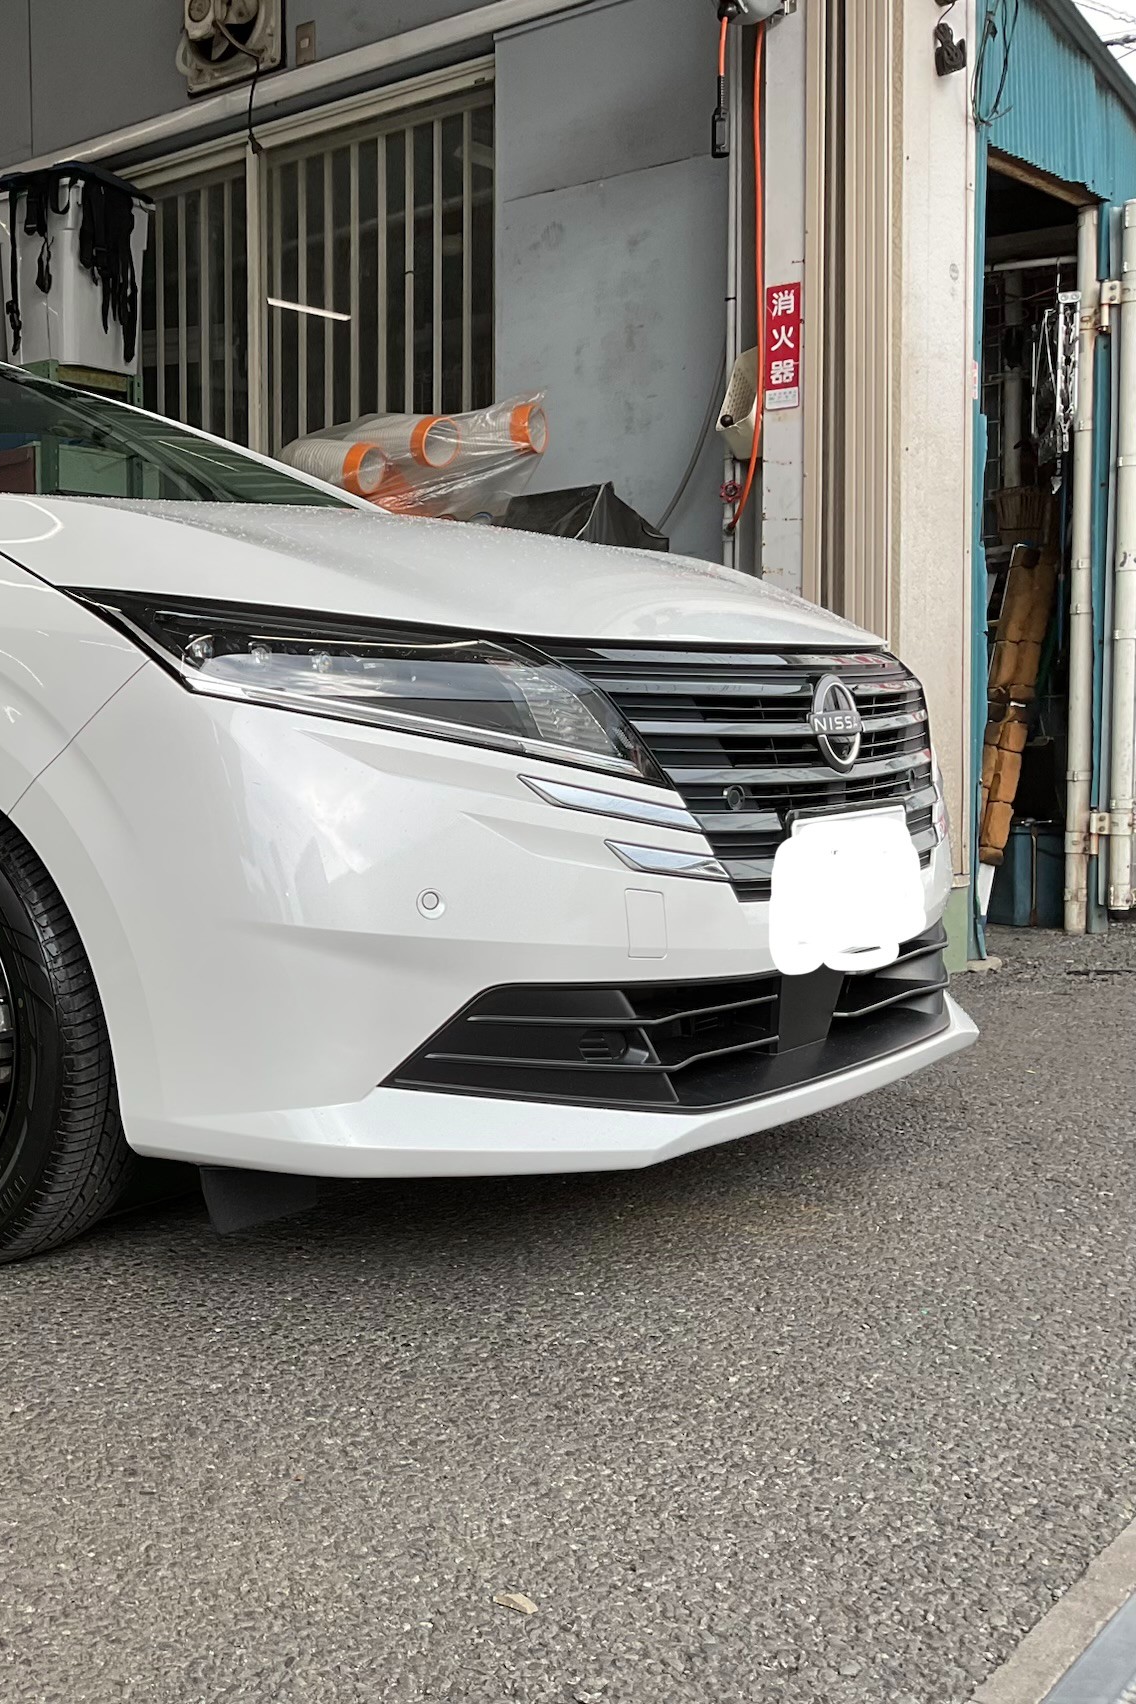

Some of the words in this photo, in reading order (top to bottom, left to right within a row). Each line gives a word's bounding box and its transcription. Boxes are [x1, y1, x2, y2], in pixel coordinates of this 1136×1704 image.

[770, 289, 795, 385] 消火器
[813, 715, 859, 732] NISS
